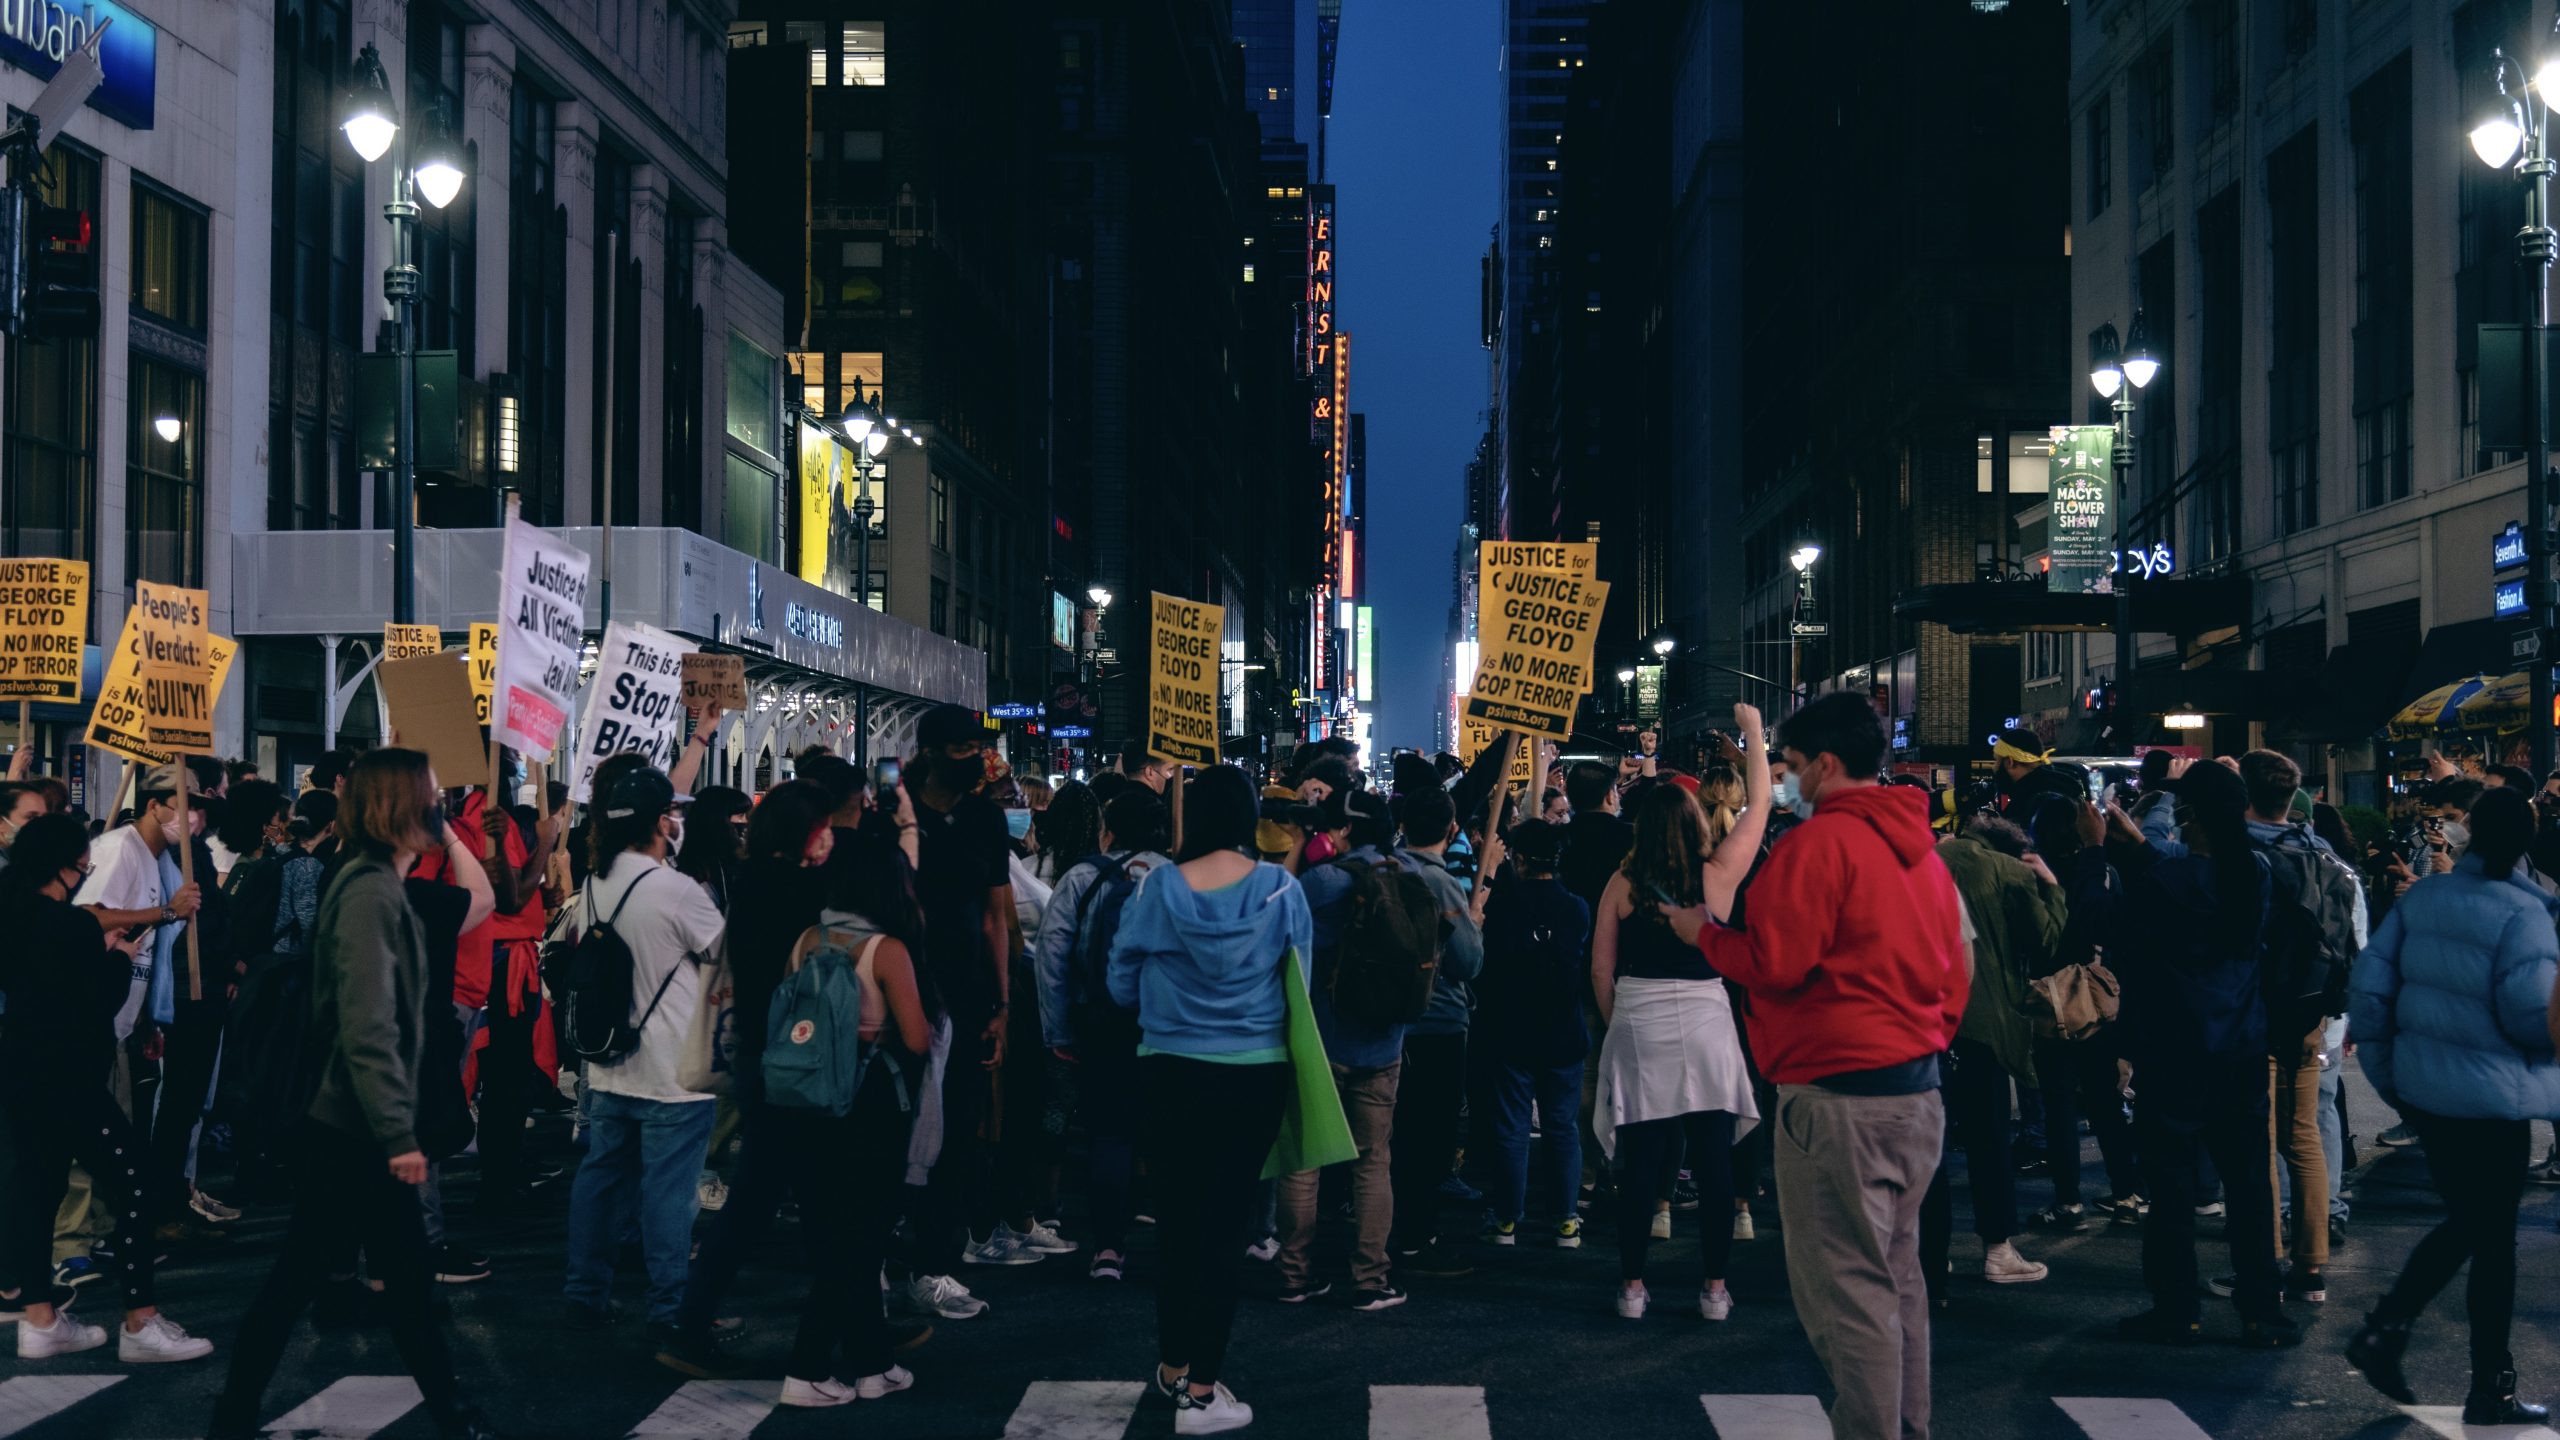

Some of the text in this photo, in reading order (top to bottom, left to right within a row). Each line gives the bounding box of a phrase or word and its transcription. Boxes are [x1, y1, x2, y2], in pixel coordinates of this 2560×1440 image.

[2057, 487, 2103, 500] MACY'S
[2054, 501, 2105, 515] FLOWER
[2059, 515, 2099, 528] SHOW
[1488, 546, 1590, 569] JUSTICE for
[2495, 541, 2518, 563] Seventh
[65, 571, 84, 586] for
[527, 550, 577, 602] Justice
[0, 588, 76, 606] GEORGE
[1505, 572, 1600, 608] JUSTICE for
[2496, 590, 2518, 611] Fashion
[4, 608, 65, 626] FLOYD
[142, 588, 200, 629] People's
[517, 593, 538, 634] All
[1155, 599, 1218, 634] JUSTICE for
[1504, 599, 1590, 632] GEORGE
[4, 635, 78, 654] NO MORE
[386, 627, 437, 644] JUSTICE for
[1157, 628, 1210, 659] GEORGE
[1506, 623, 1574, 653] FLOYD
[143, 630, 201, 667] Verdict:
[209, 647, 228, 663] for
[387, 645, 436, 658] GEORGE
[624, 641, 659, 673] This
[659, 651, 672, 676] is
[24, 656, 77, 676] TERROR
[1160, 653, 1201, 681] FLOYD
[1482, 651, 1580, 685] is NO MORE
[107, 686, 121, 700] is
[146, 677, 208, 721] GUILTY!
[609, 671, 670, 729] Stop
[683, 679, 739, 699] JUSTICE
[1159, 682, 1171, 703] NO
[1174, 687, 1212, 715] MORE
[1476, 673, 1574, 711] COP TERROR
[100, 703, 134, 726] COP
[992, 707, 1034, 716] West 35th St
[1485, 702, 1551, 730] pslweb.org
[1069, 728, 1081, 736] 35th
[1153, 706, 1214, 742] COP TERROR
[108, 734, 174, 763] pslweb.org
[1463, 752, 1472, 764] is
